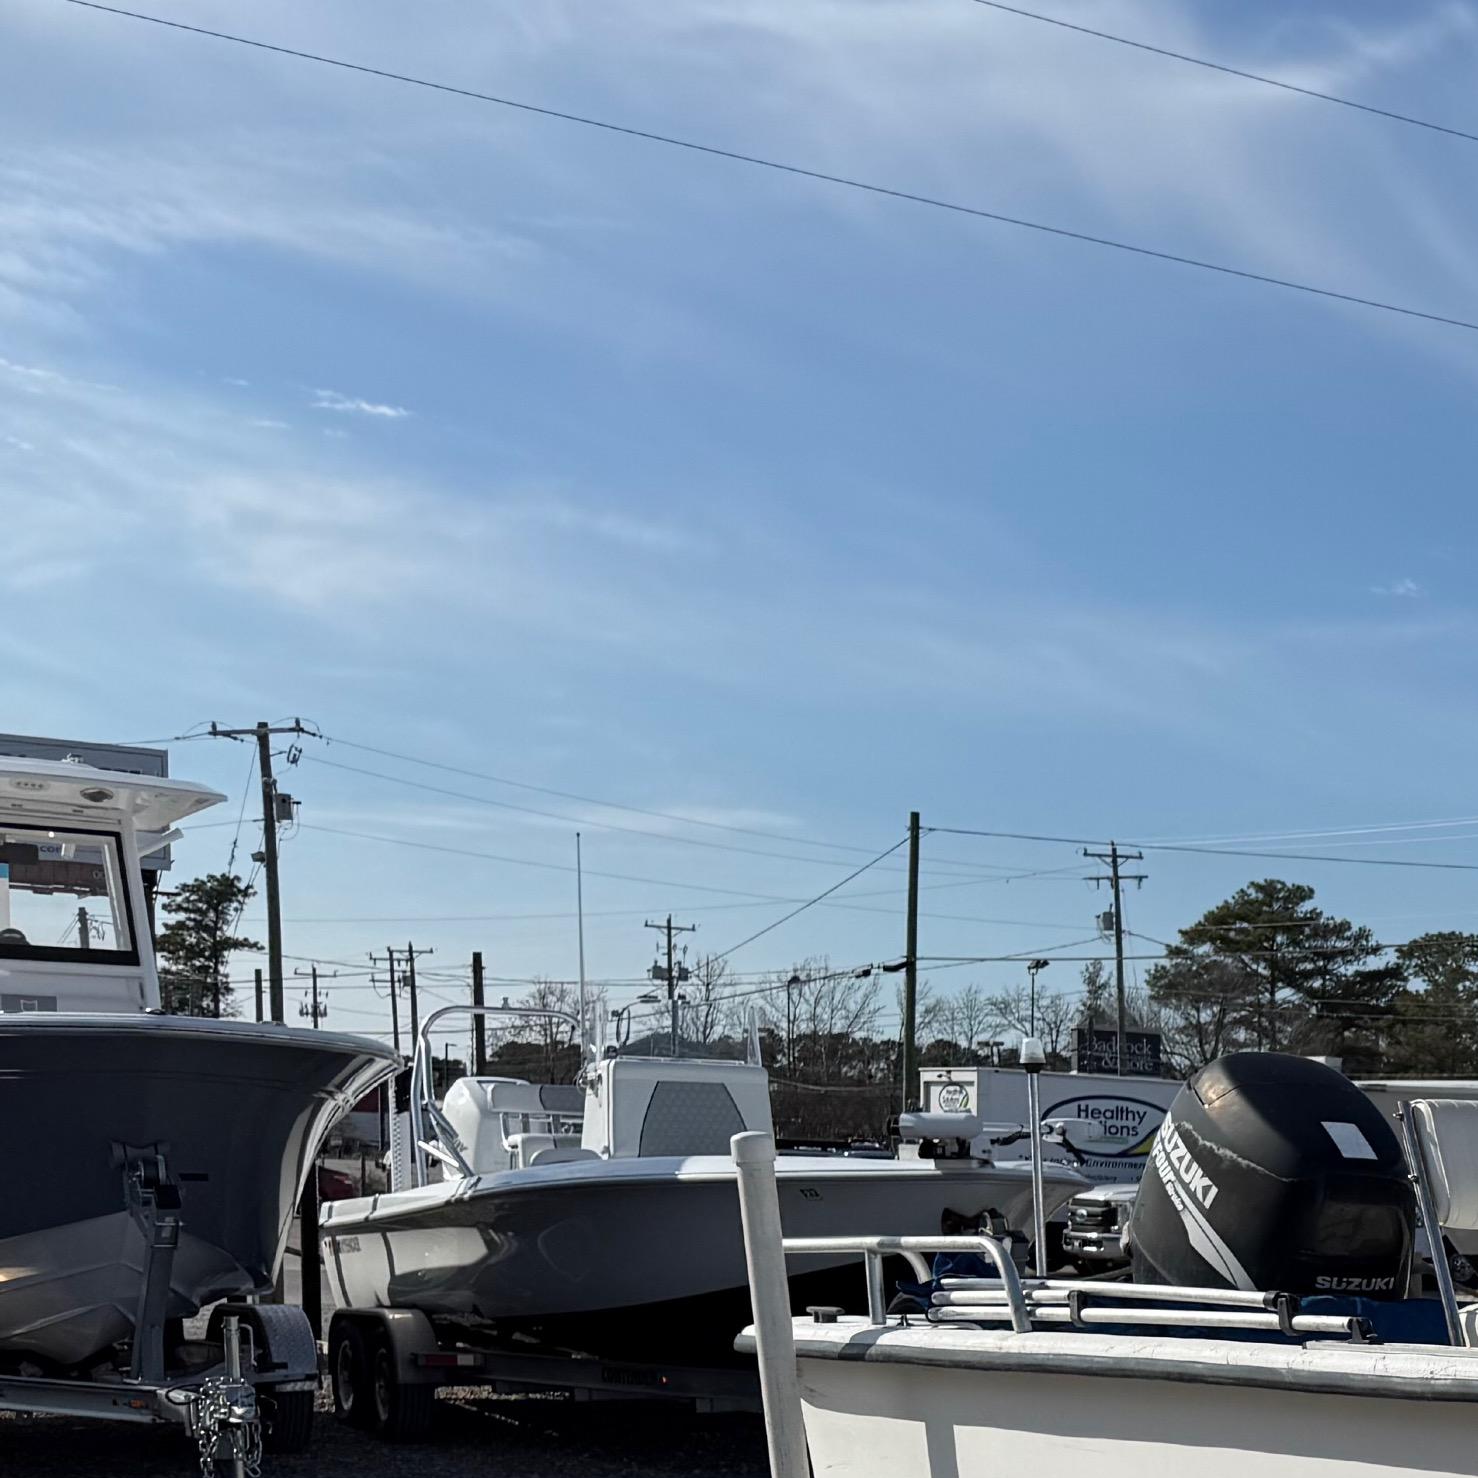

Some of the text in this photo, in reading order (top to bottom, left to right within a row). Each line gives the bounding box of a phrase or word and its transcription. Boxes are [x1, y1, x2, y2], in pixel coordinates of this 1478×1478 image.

[1088, 1034, 1152, 1055] Badock
[1077, 1103, 1147, 1125] Healthy
[1161, 1110, 1218, 1210] SUZUKI
[1315, 1275, 1395, 1291] SUZUKI
